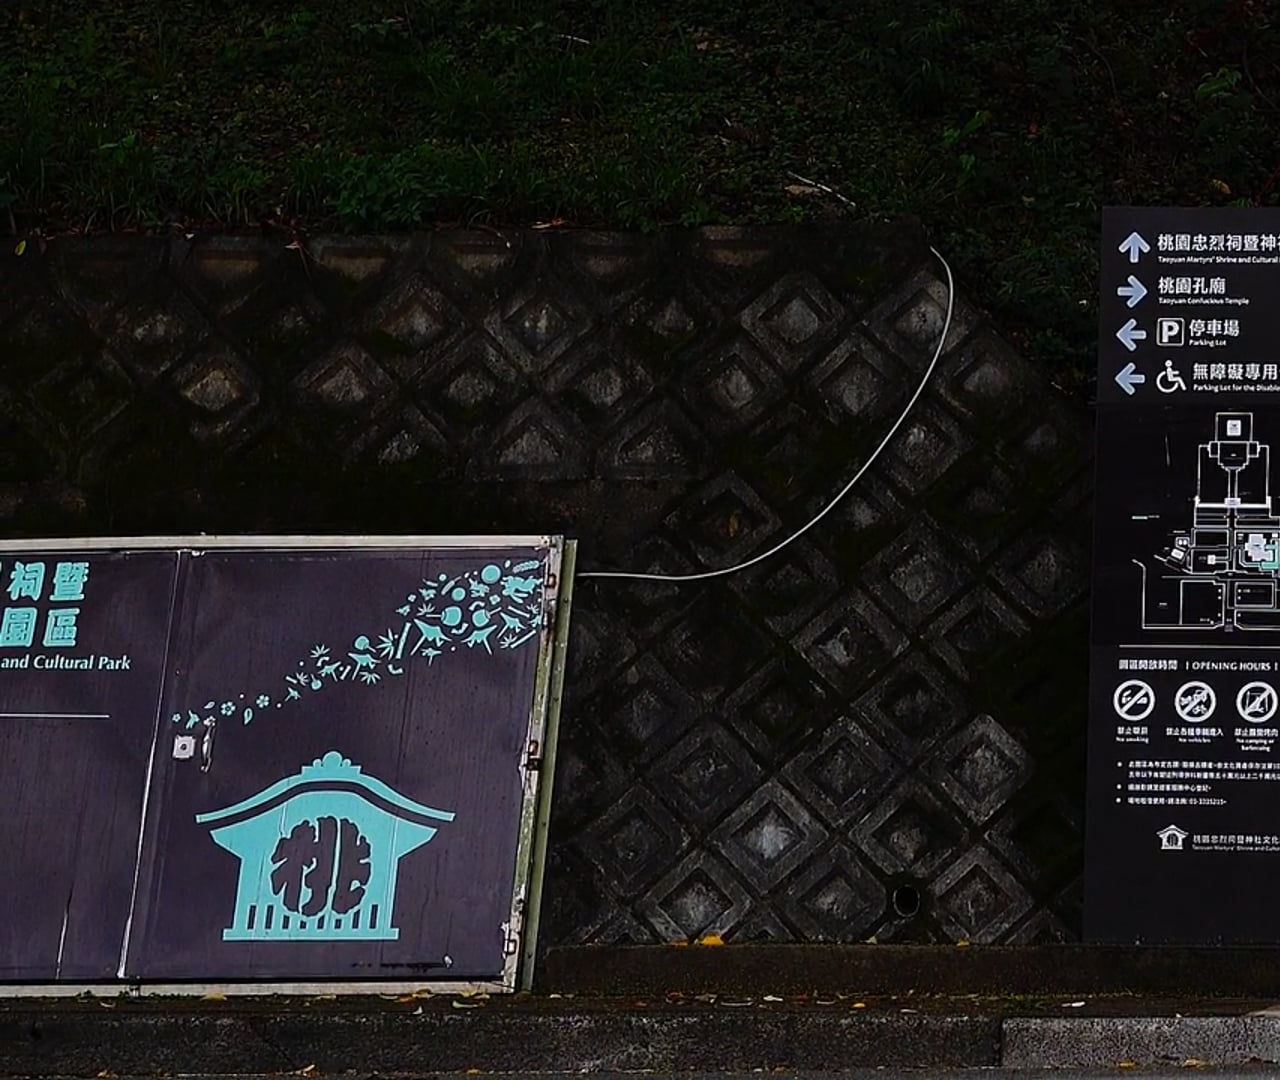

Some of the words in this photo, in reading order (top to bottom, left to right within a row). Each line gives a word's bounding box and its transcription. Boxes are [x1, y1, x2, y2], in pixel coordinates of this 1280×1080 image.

[1158, 276, 1226, 294] 桃園孔廟
[1189, 319, 1240, 337] 停車場
[1189, 339, 1215, 348] Parking
[1, 654, 30, 669] and
[33, 654, 95, 669] Cultural
[98, 655, 132, 670] Park
[1192, 661, 1238, 671] OPENING
[1239, 662, 1272, 671] HOURS
